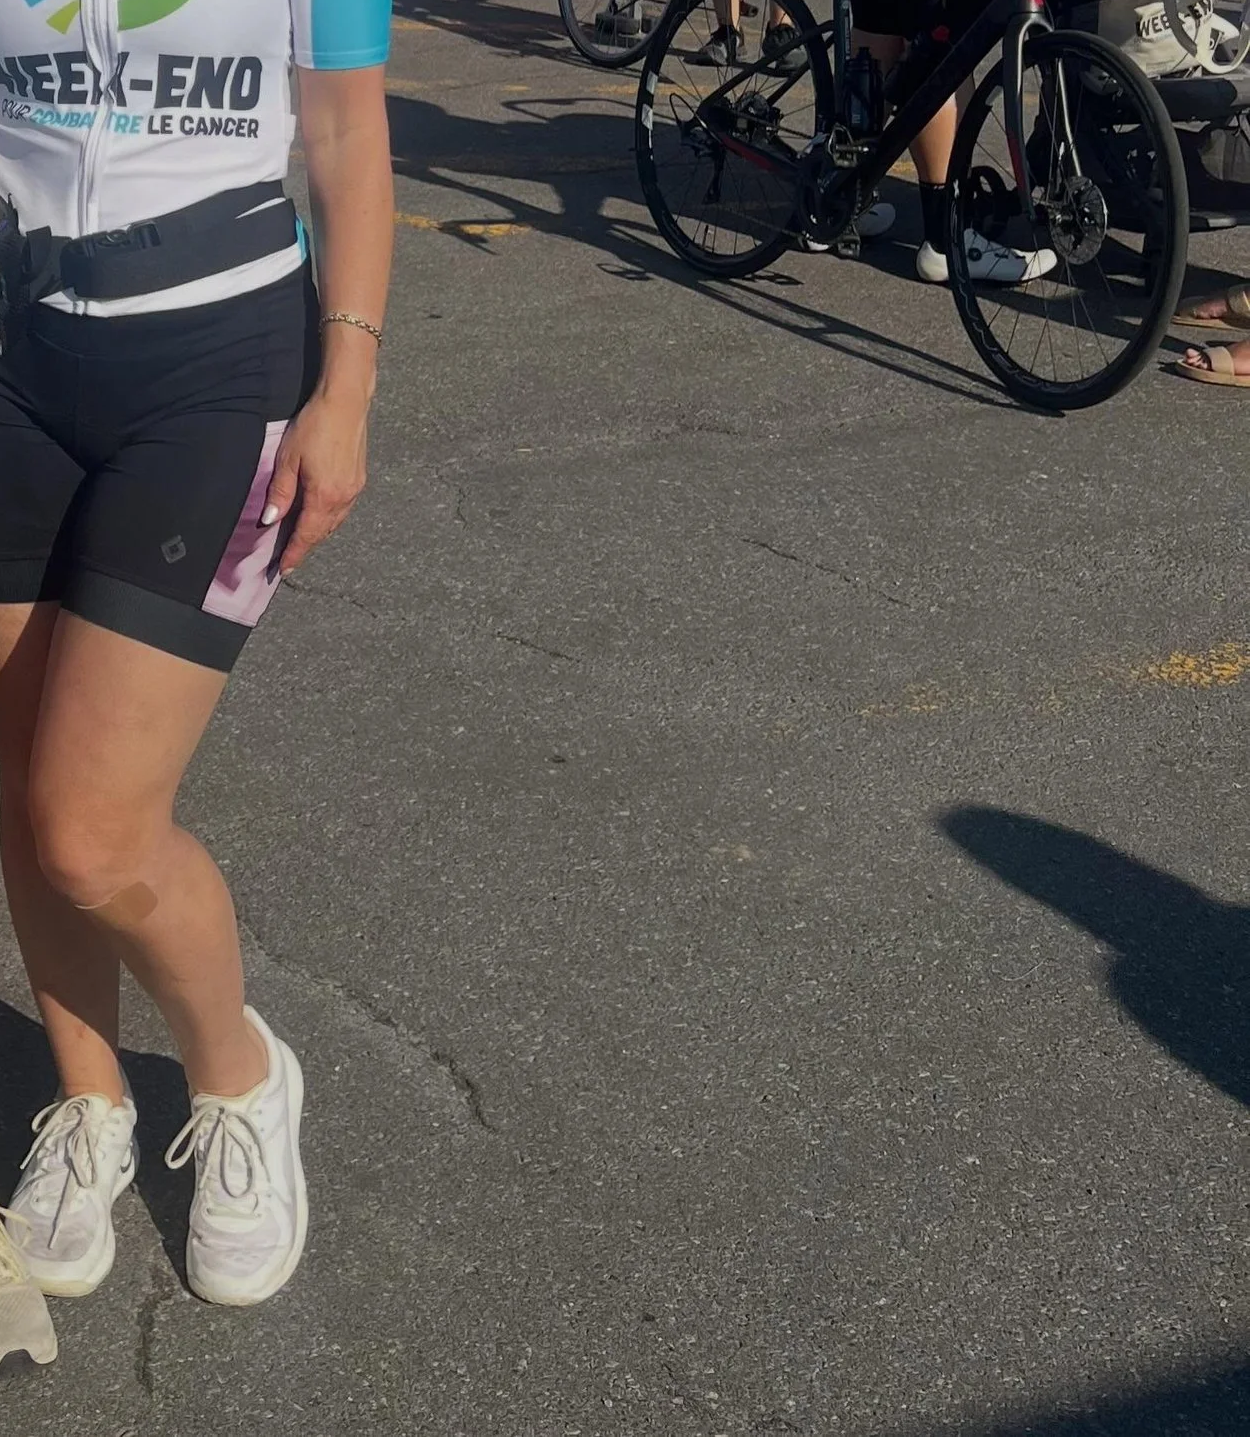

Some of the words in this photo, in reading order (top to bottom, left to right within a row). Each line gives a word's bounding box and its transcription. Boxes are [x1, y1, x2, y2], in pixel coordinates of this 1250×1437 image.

[30, 107, 144, 135] COMBATRE
[147, 115, 174, 135] LE
[180, 115, 260, 139] CANCER
